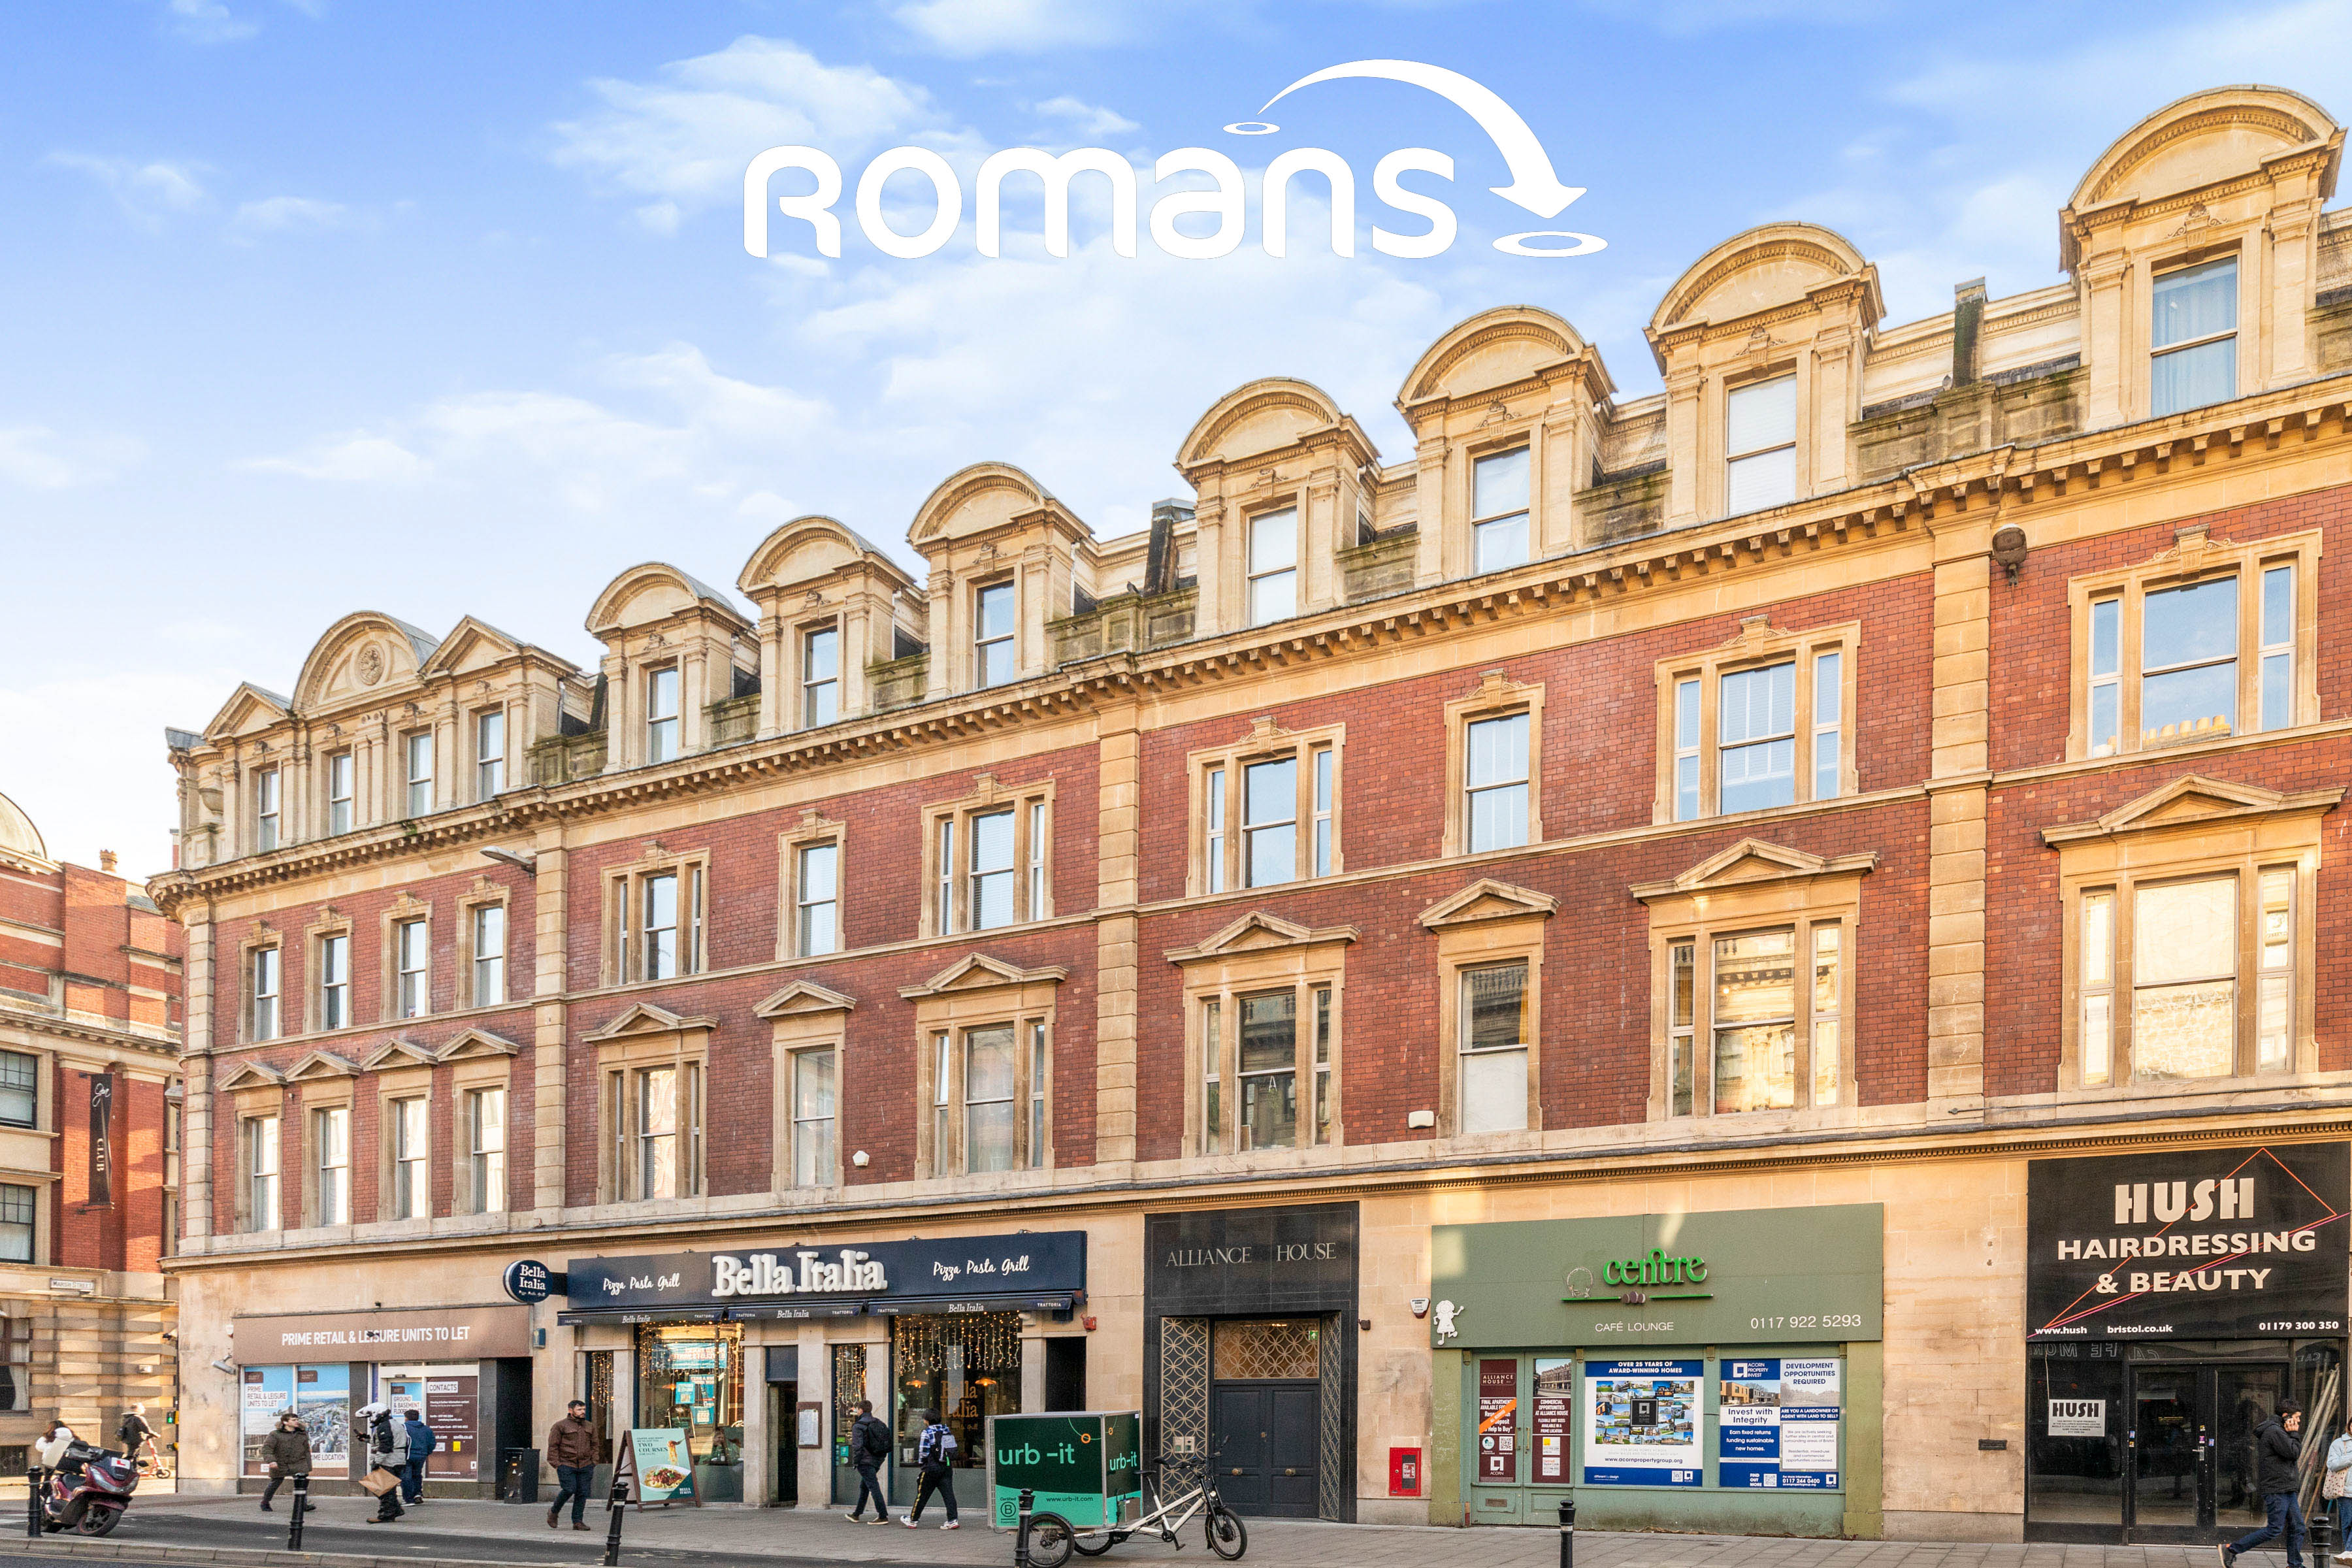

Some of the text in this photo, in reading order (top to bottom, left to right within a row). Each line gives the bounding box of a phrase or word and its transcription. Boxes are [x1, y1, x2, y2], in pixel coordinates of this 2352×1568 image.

[2114, 1178, 2254, 1224] HUSH
[1166, 1243, 1337, 1267] ALLIANCE HOUSE
[2057, 1230, 2315, 1260] HAIRDRESSING
[711, 1249, 888, 1297] Bella Italia
[934, 1255, 1030, 1281] Pizza Pasta Grill
[1603, 1248, 1707, 1285] centre
[519, 1264, 546, 1290] Bella Italia
[603, 1273, 680, 1296] Pizza Pasta Grill
[2096, 1268, 2272, 1294] & BEAUTY
[776, 1310, 792, 1318] Bella
[792, 1309, 809, 1318] Italia
[948, 1303, 966, 1313] Bella
[966, 1303, 984, 1311] Italia
[622, 1315, 636, 1324] Bella
[1595, 1321, 1674, 1332] CAFÉ LOUNGE
[1750, 1315, 1861, 1329] 0117 922 5293
[2107, 1325, 2173, 1333] bristol.co.uk
[2259, 1322, 2293, 1330] 01179
[2318, 1321, 2339, 1330] 350
[282, 1326, 470, 1346] PRIME RETAIL & LEISURE UNITS TO LET
[2052, 1403, 2099, 1417] HUSH
[1109, 1451, 1137, 1471] urb-it
